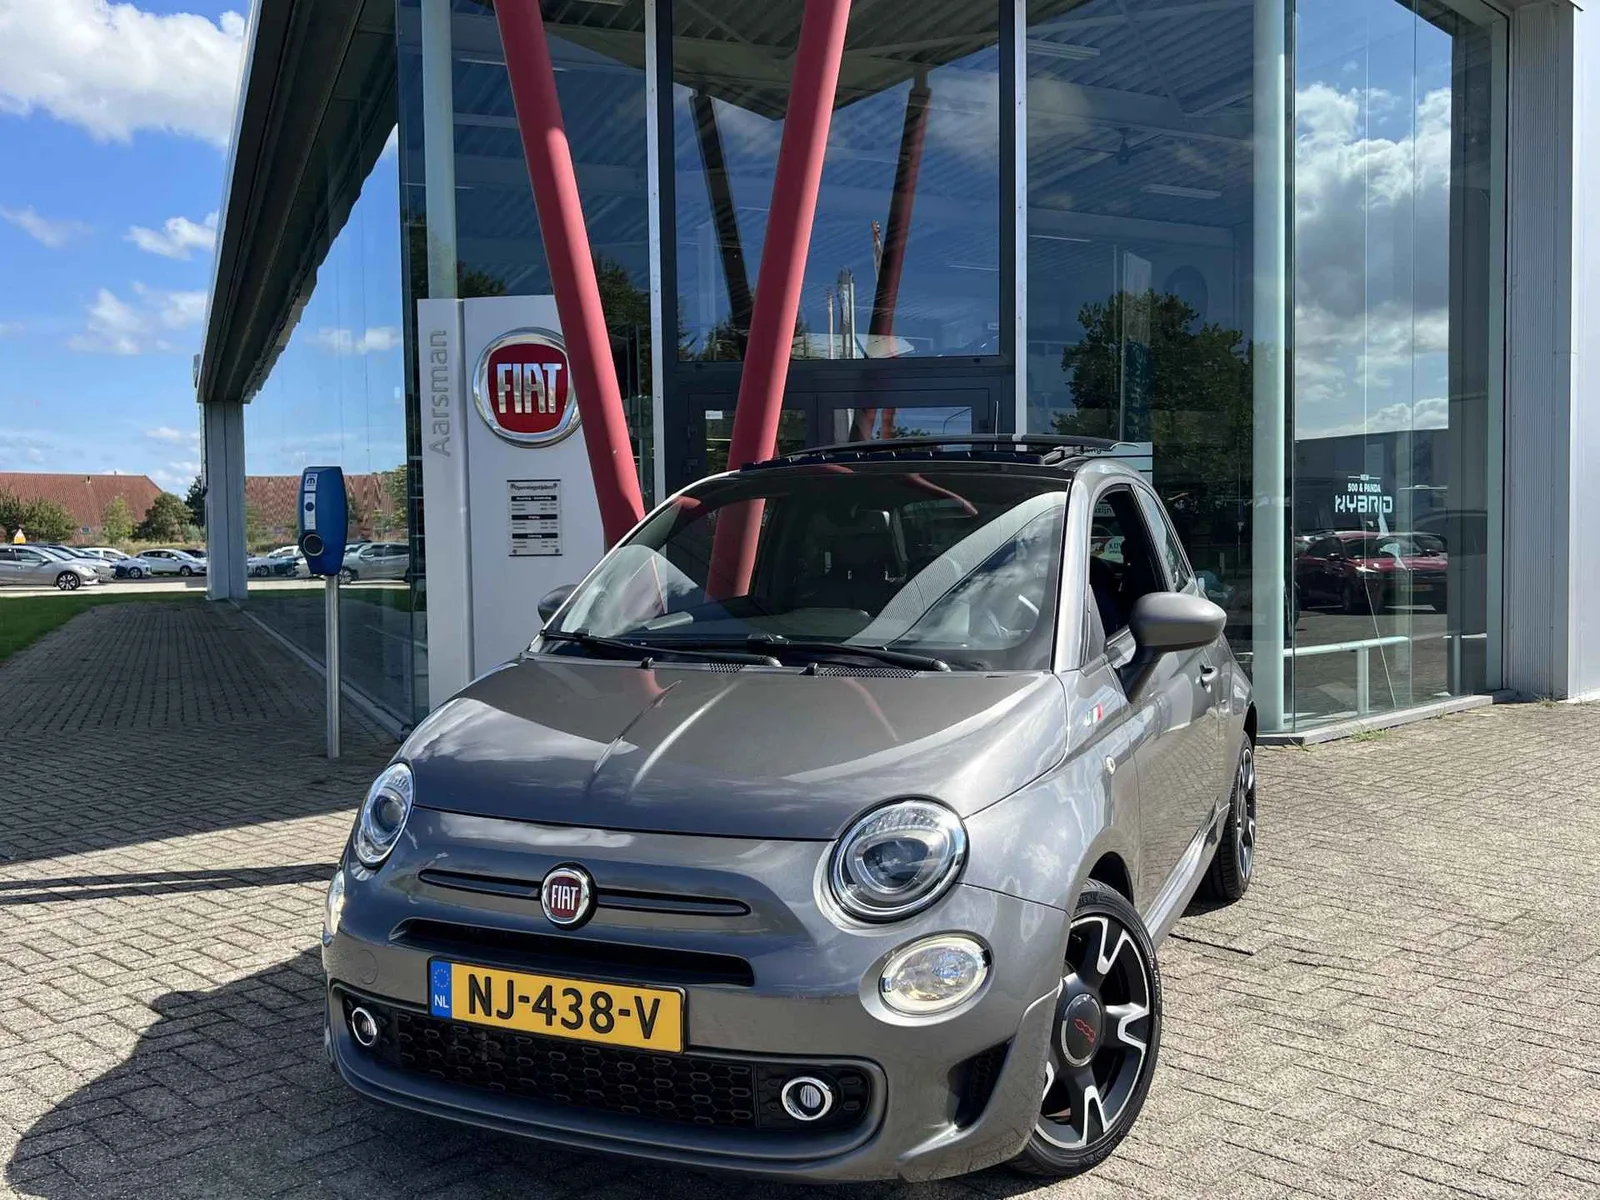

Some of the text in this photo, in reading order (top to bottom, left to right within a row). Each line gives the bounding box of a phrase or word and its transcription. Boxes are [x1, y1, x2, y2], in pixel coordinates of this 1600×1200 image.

[429, 330, 450, 457] Aarsman
[496, 363, 562, 414] FIAT
[1348, 483, 1358, 492] 500
[1364, 483, 1381, 493] PANDA
[1335, 495, 1393, 513] HYBRID
[551, 884, 579, 911] FIAT
[434, 994, 449, 1009] NL
[467, 973, 661, 1040] NJ-438-V
